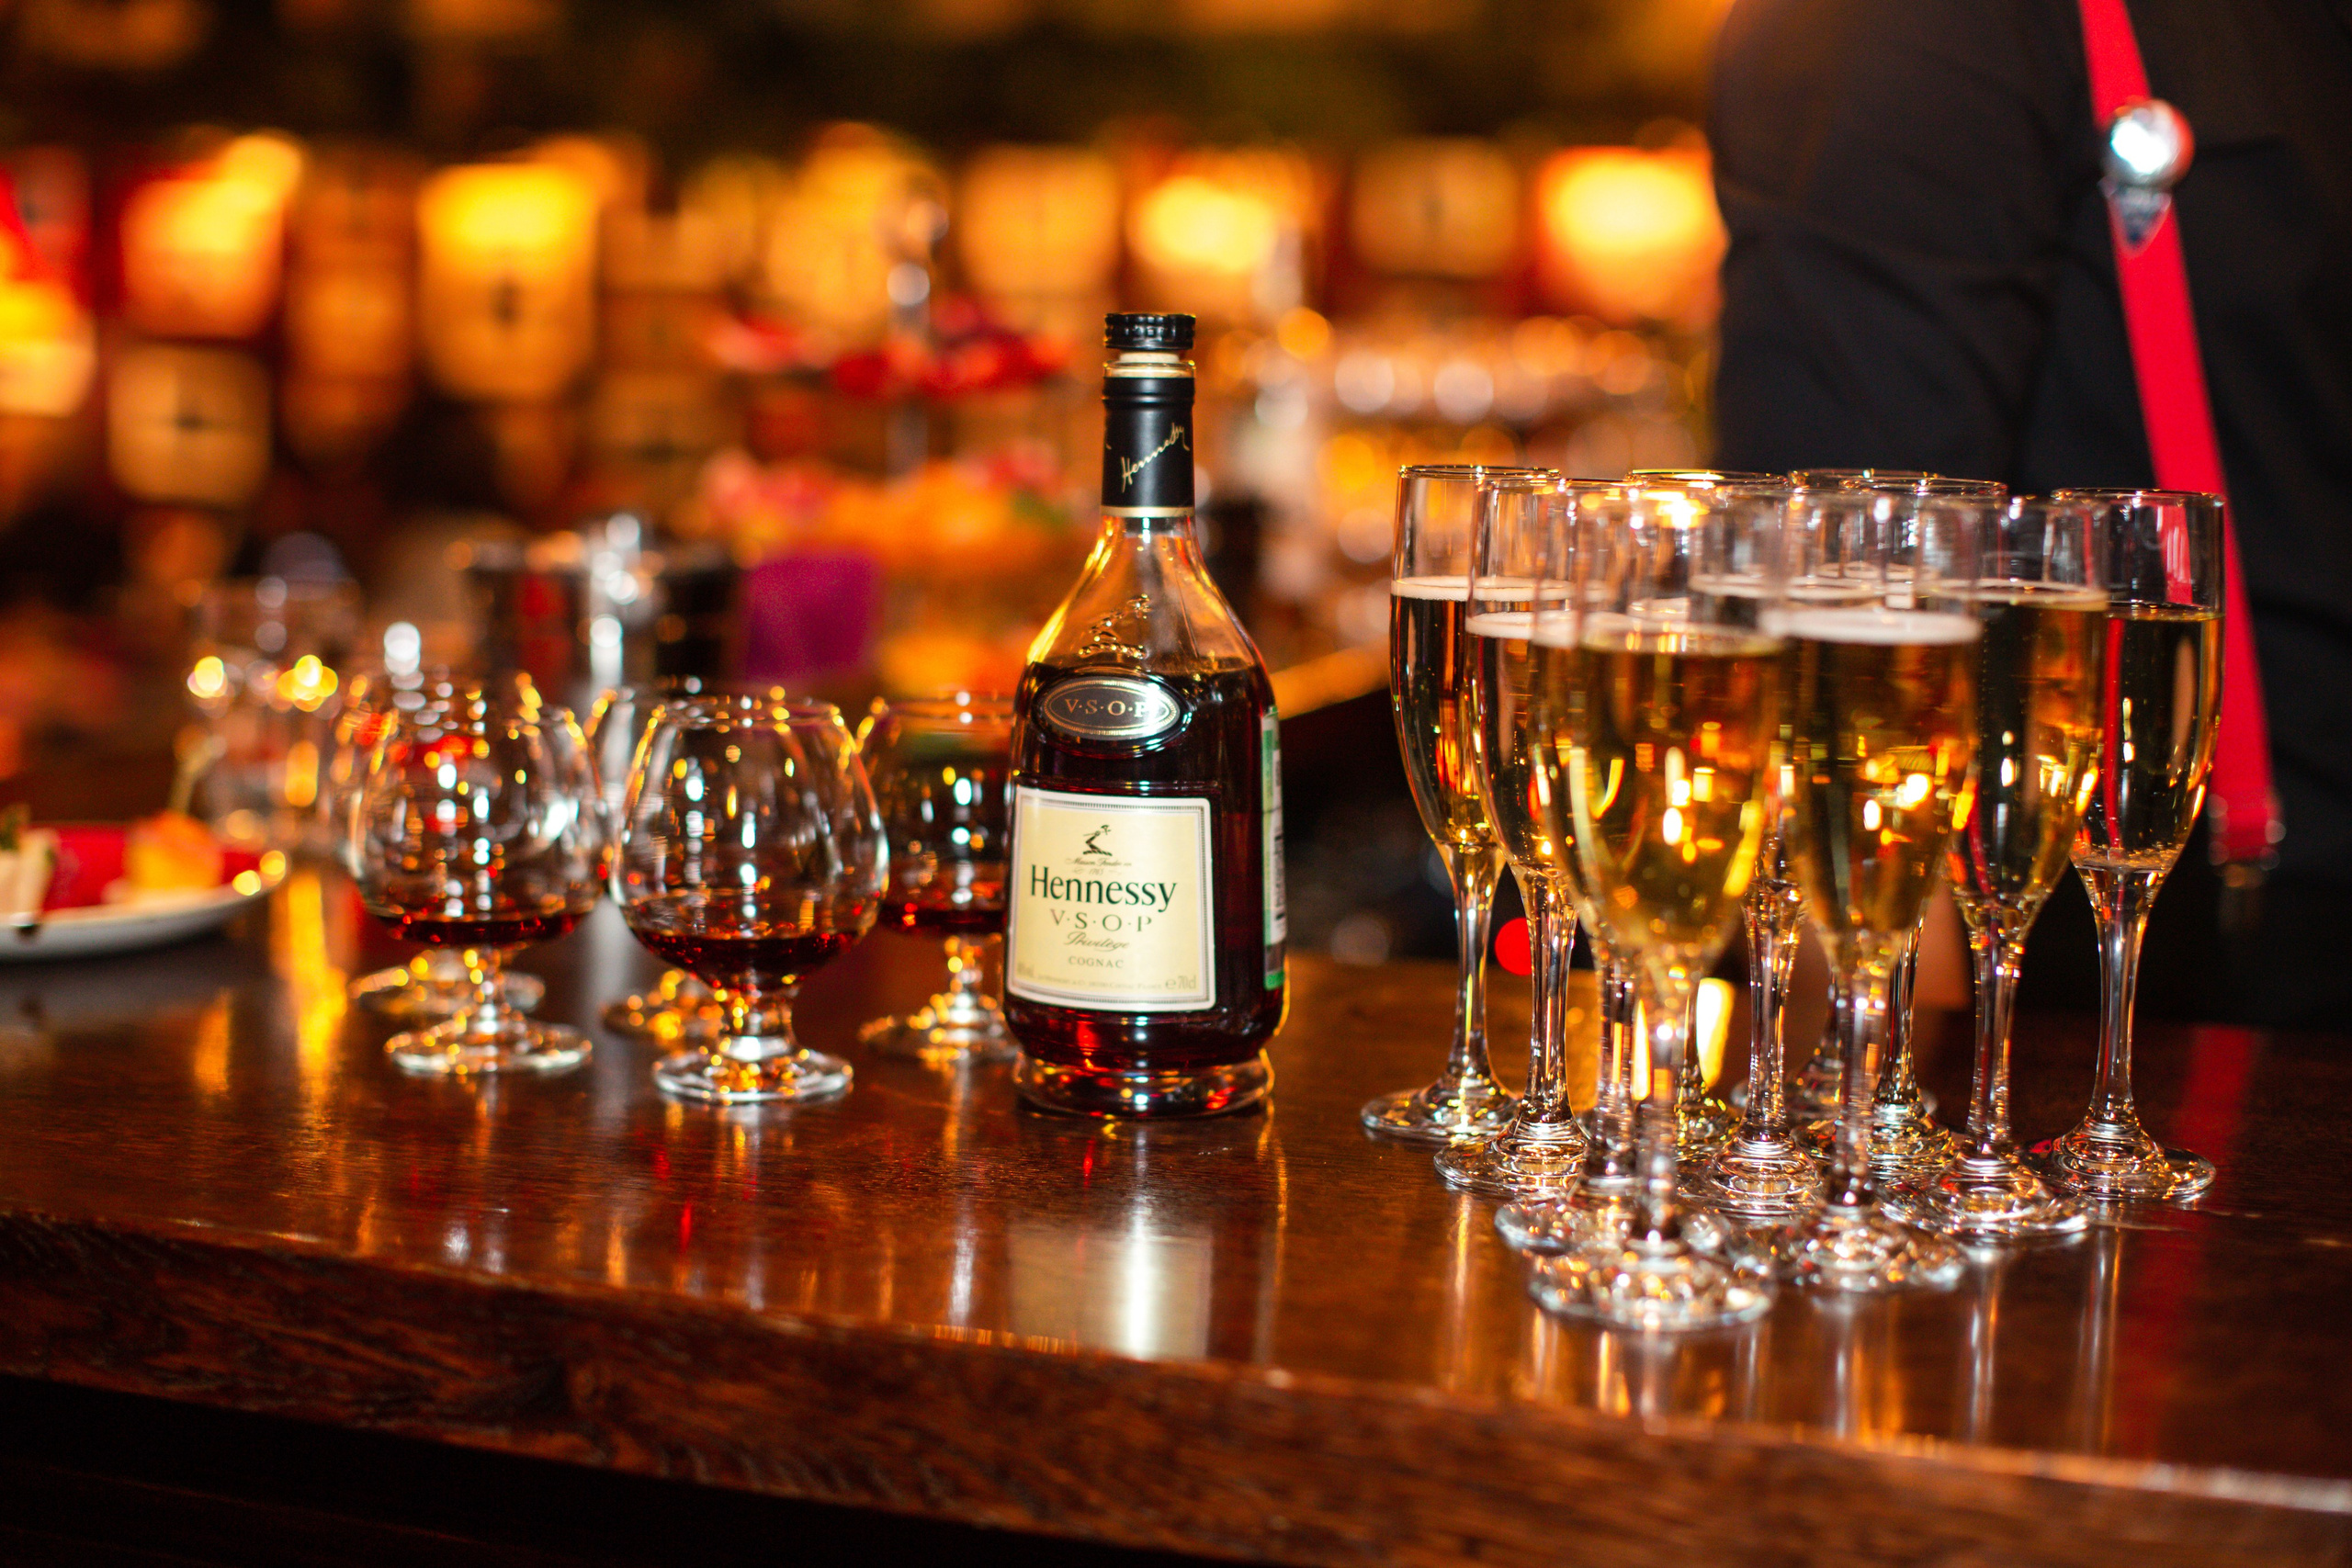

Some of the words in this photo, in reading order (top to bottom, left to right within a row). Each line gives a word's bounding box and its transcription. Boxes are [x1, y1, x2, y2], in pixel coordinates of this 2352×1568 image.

[1120, 422, 1191, 493] Hennessy
[1030, 863, 1177, 913] Hennessy
[1068, 955, 1125, 969] COGNAC
